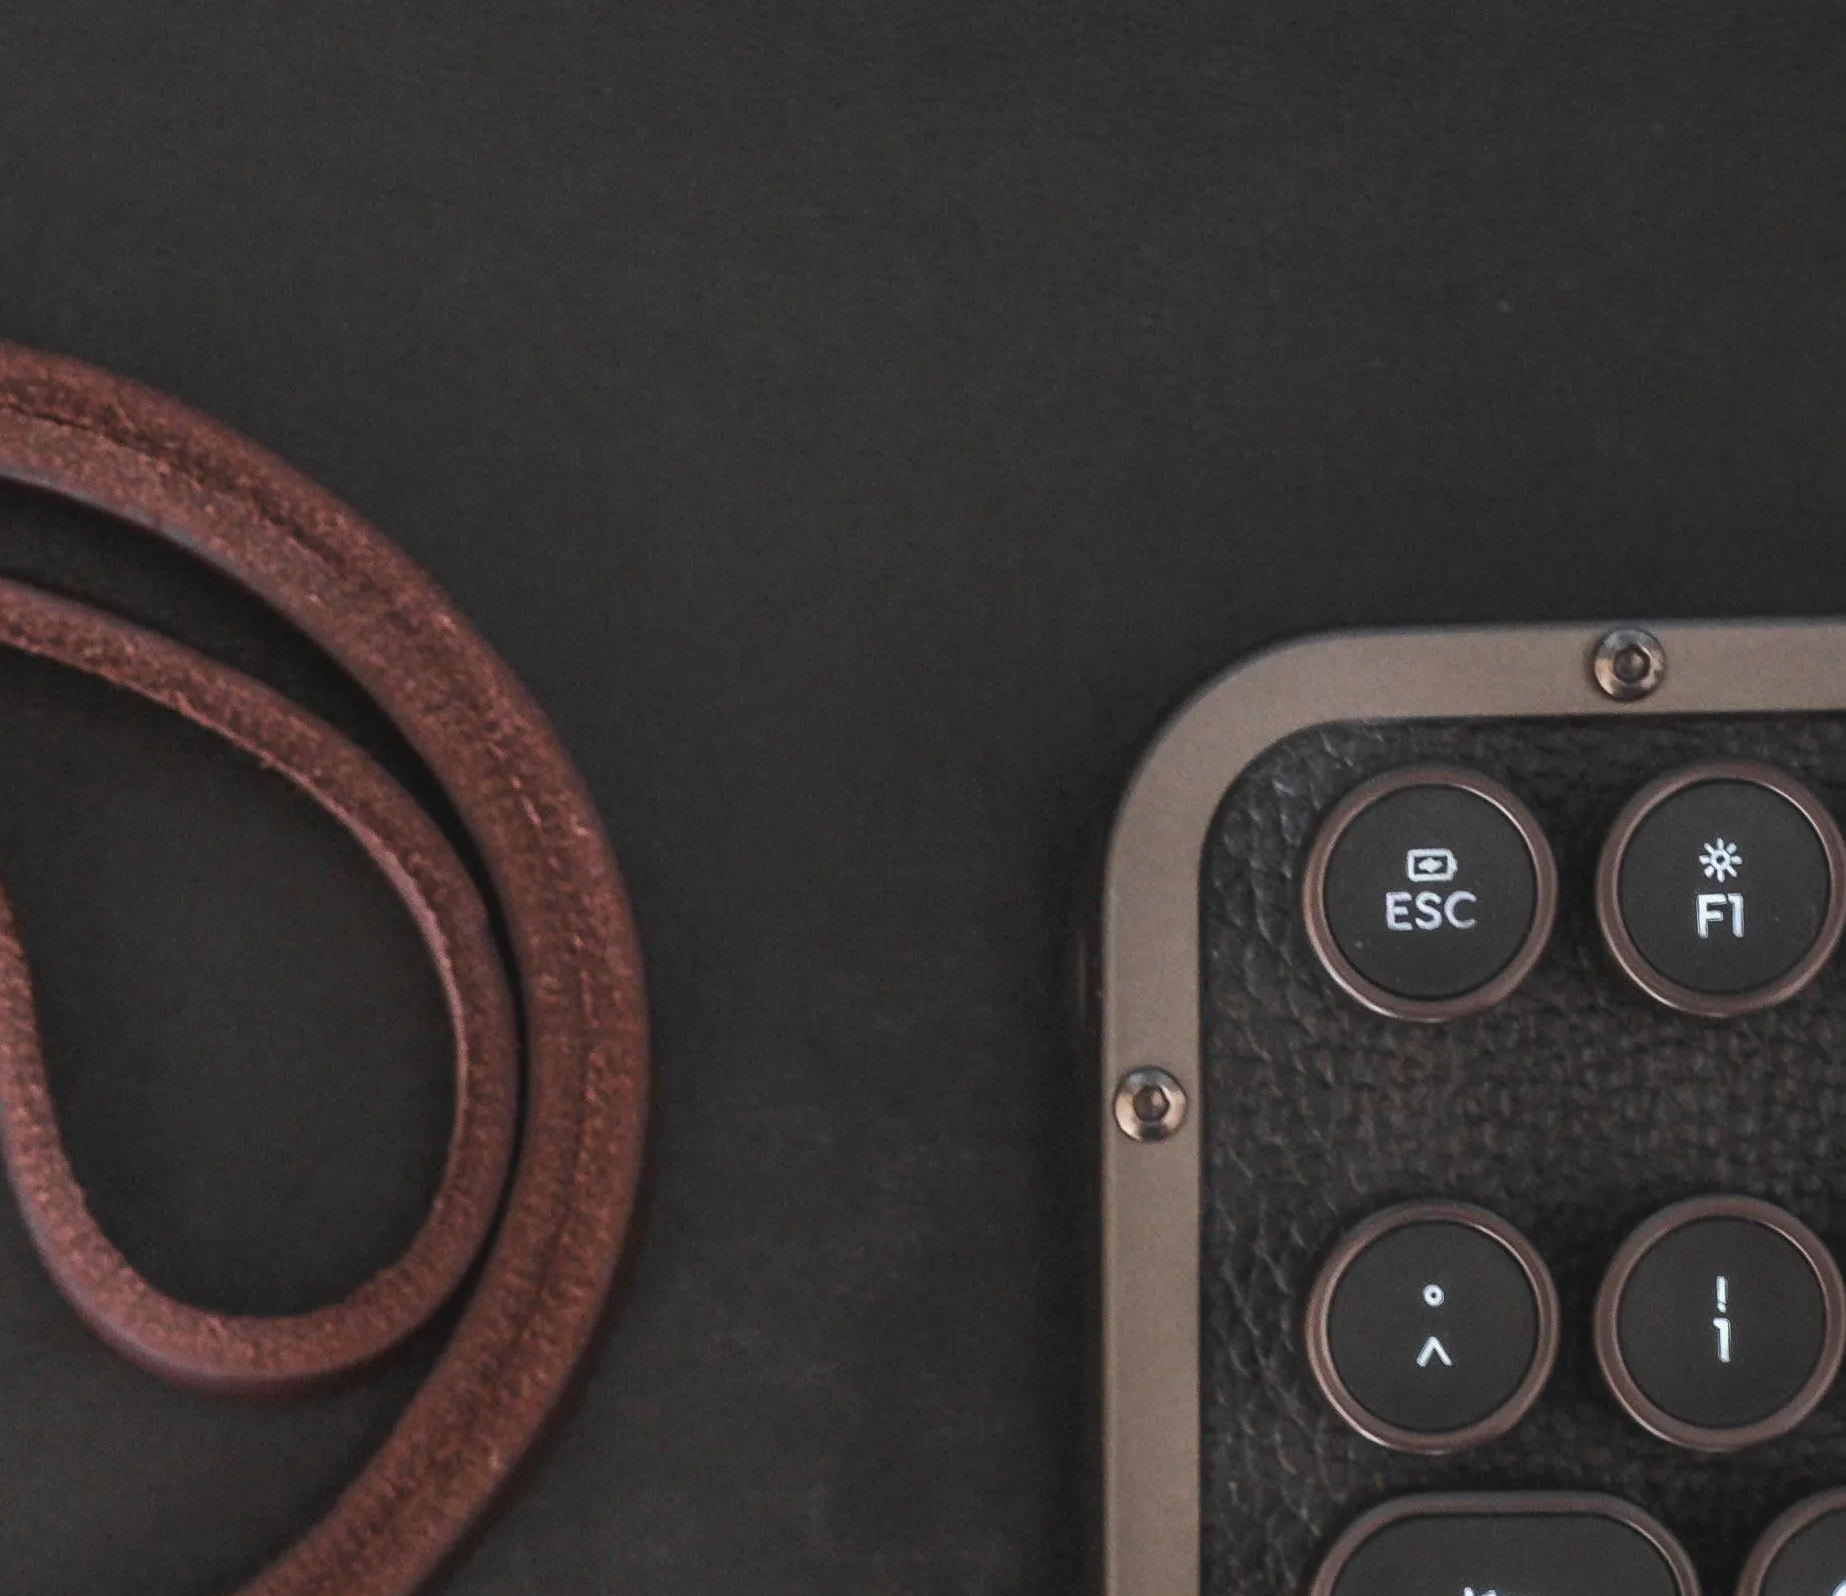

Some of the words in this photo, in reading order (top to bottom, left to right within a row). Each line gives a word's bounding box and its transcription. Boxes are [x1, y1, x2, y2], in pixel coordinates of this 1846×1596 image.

[1385, 890, 1478, 932] ESC
[1695, 892, 1746, 939] F1
[1711, 1317, 1731, 1363] 1
